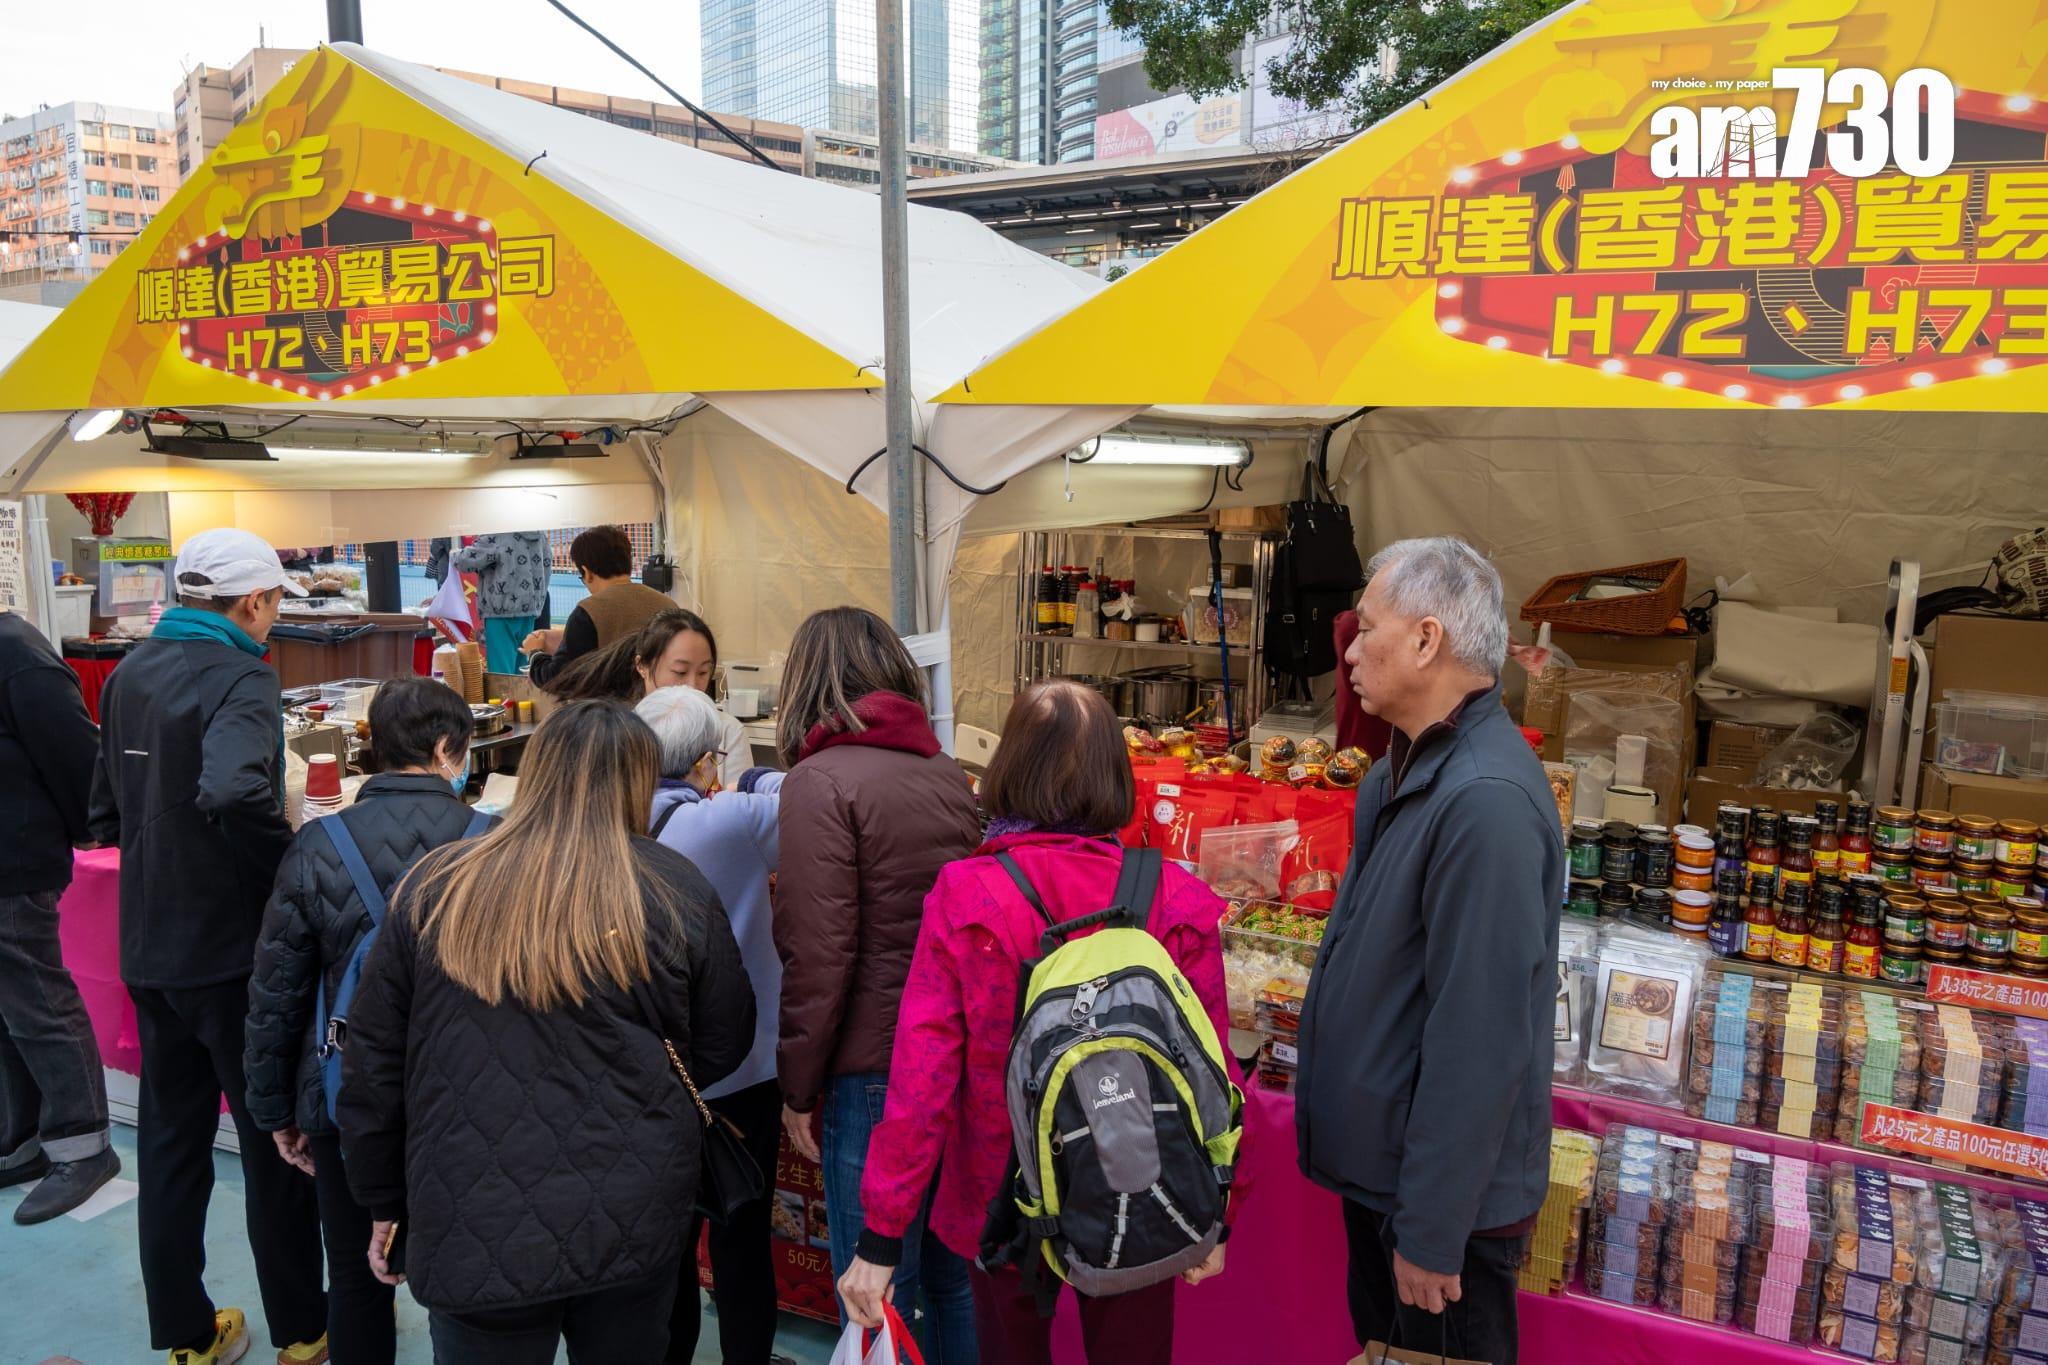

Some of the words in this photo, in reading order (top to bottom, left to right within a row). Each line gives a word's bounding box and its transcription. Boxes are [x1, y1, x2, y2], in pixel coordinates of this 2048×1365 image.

[138, 235, 555, 323] 順達(香港)貿易公司
